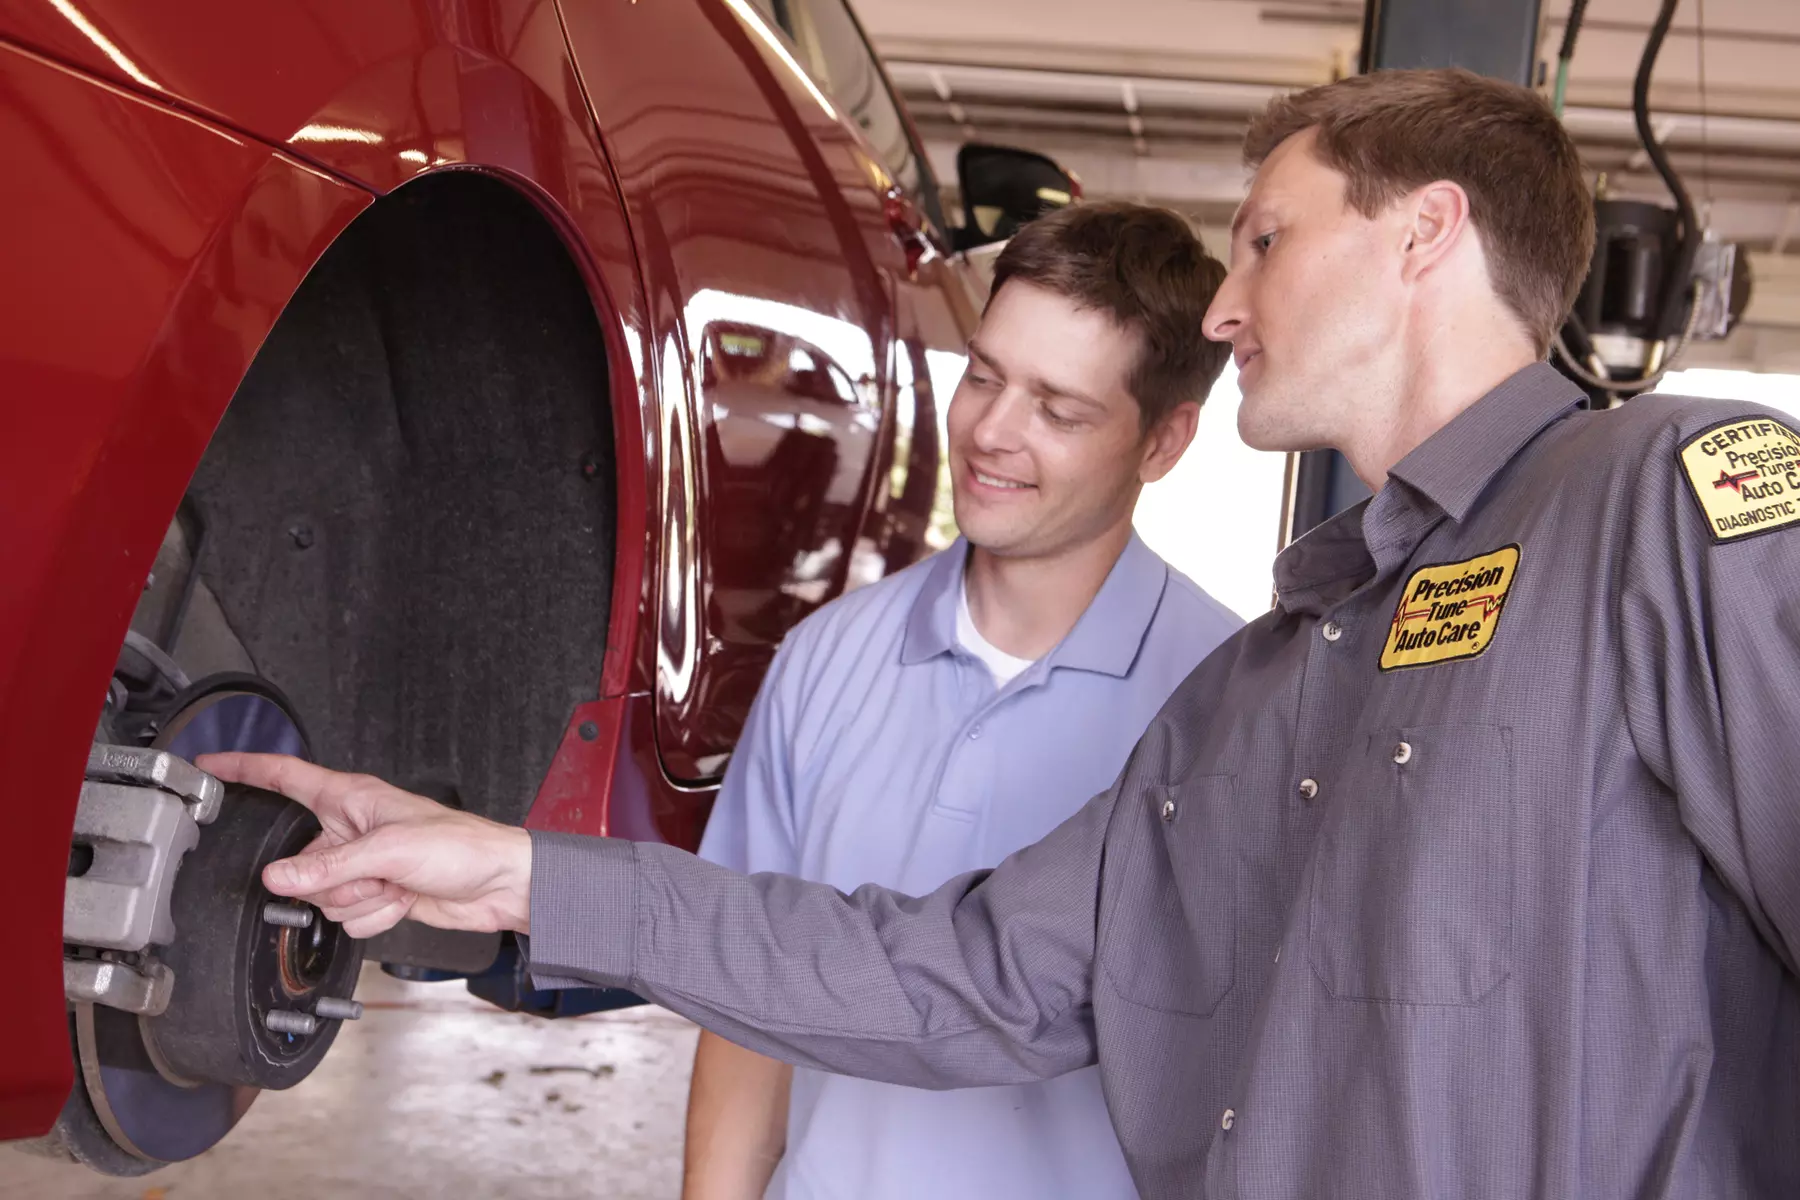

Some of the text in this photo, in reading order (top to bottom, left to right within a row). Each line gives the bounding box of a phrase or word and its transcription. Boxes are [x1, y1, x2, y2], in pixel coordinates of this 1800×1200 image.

[1756, 460, 1796, 478] Tune
[1741, 481, 1784, 502] Auto
[1715, 501, 1796, 532] DIAGNOSTIC
[1410, 566, 1505, 603] Precision
[1427, 600, 1468, 622] Tune
